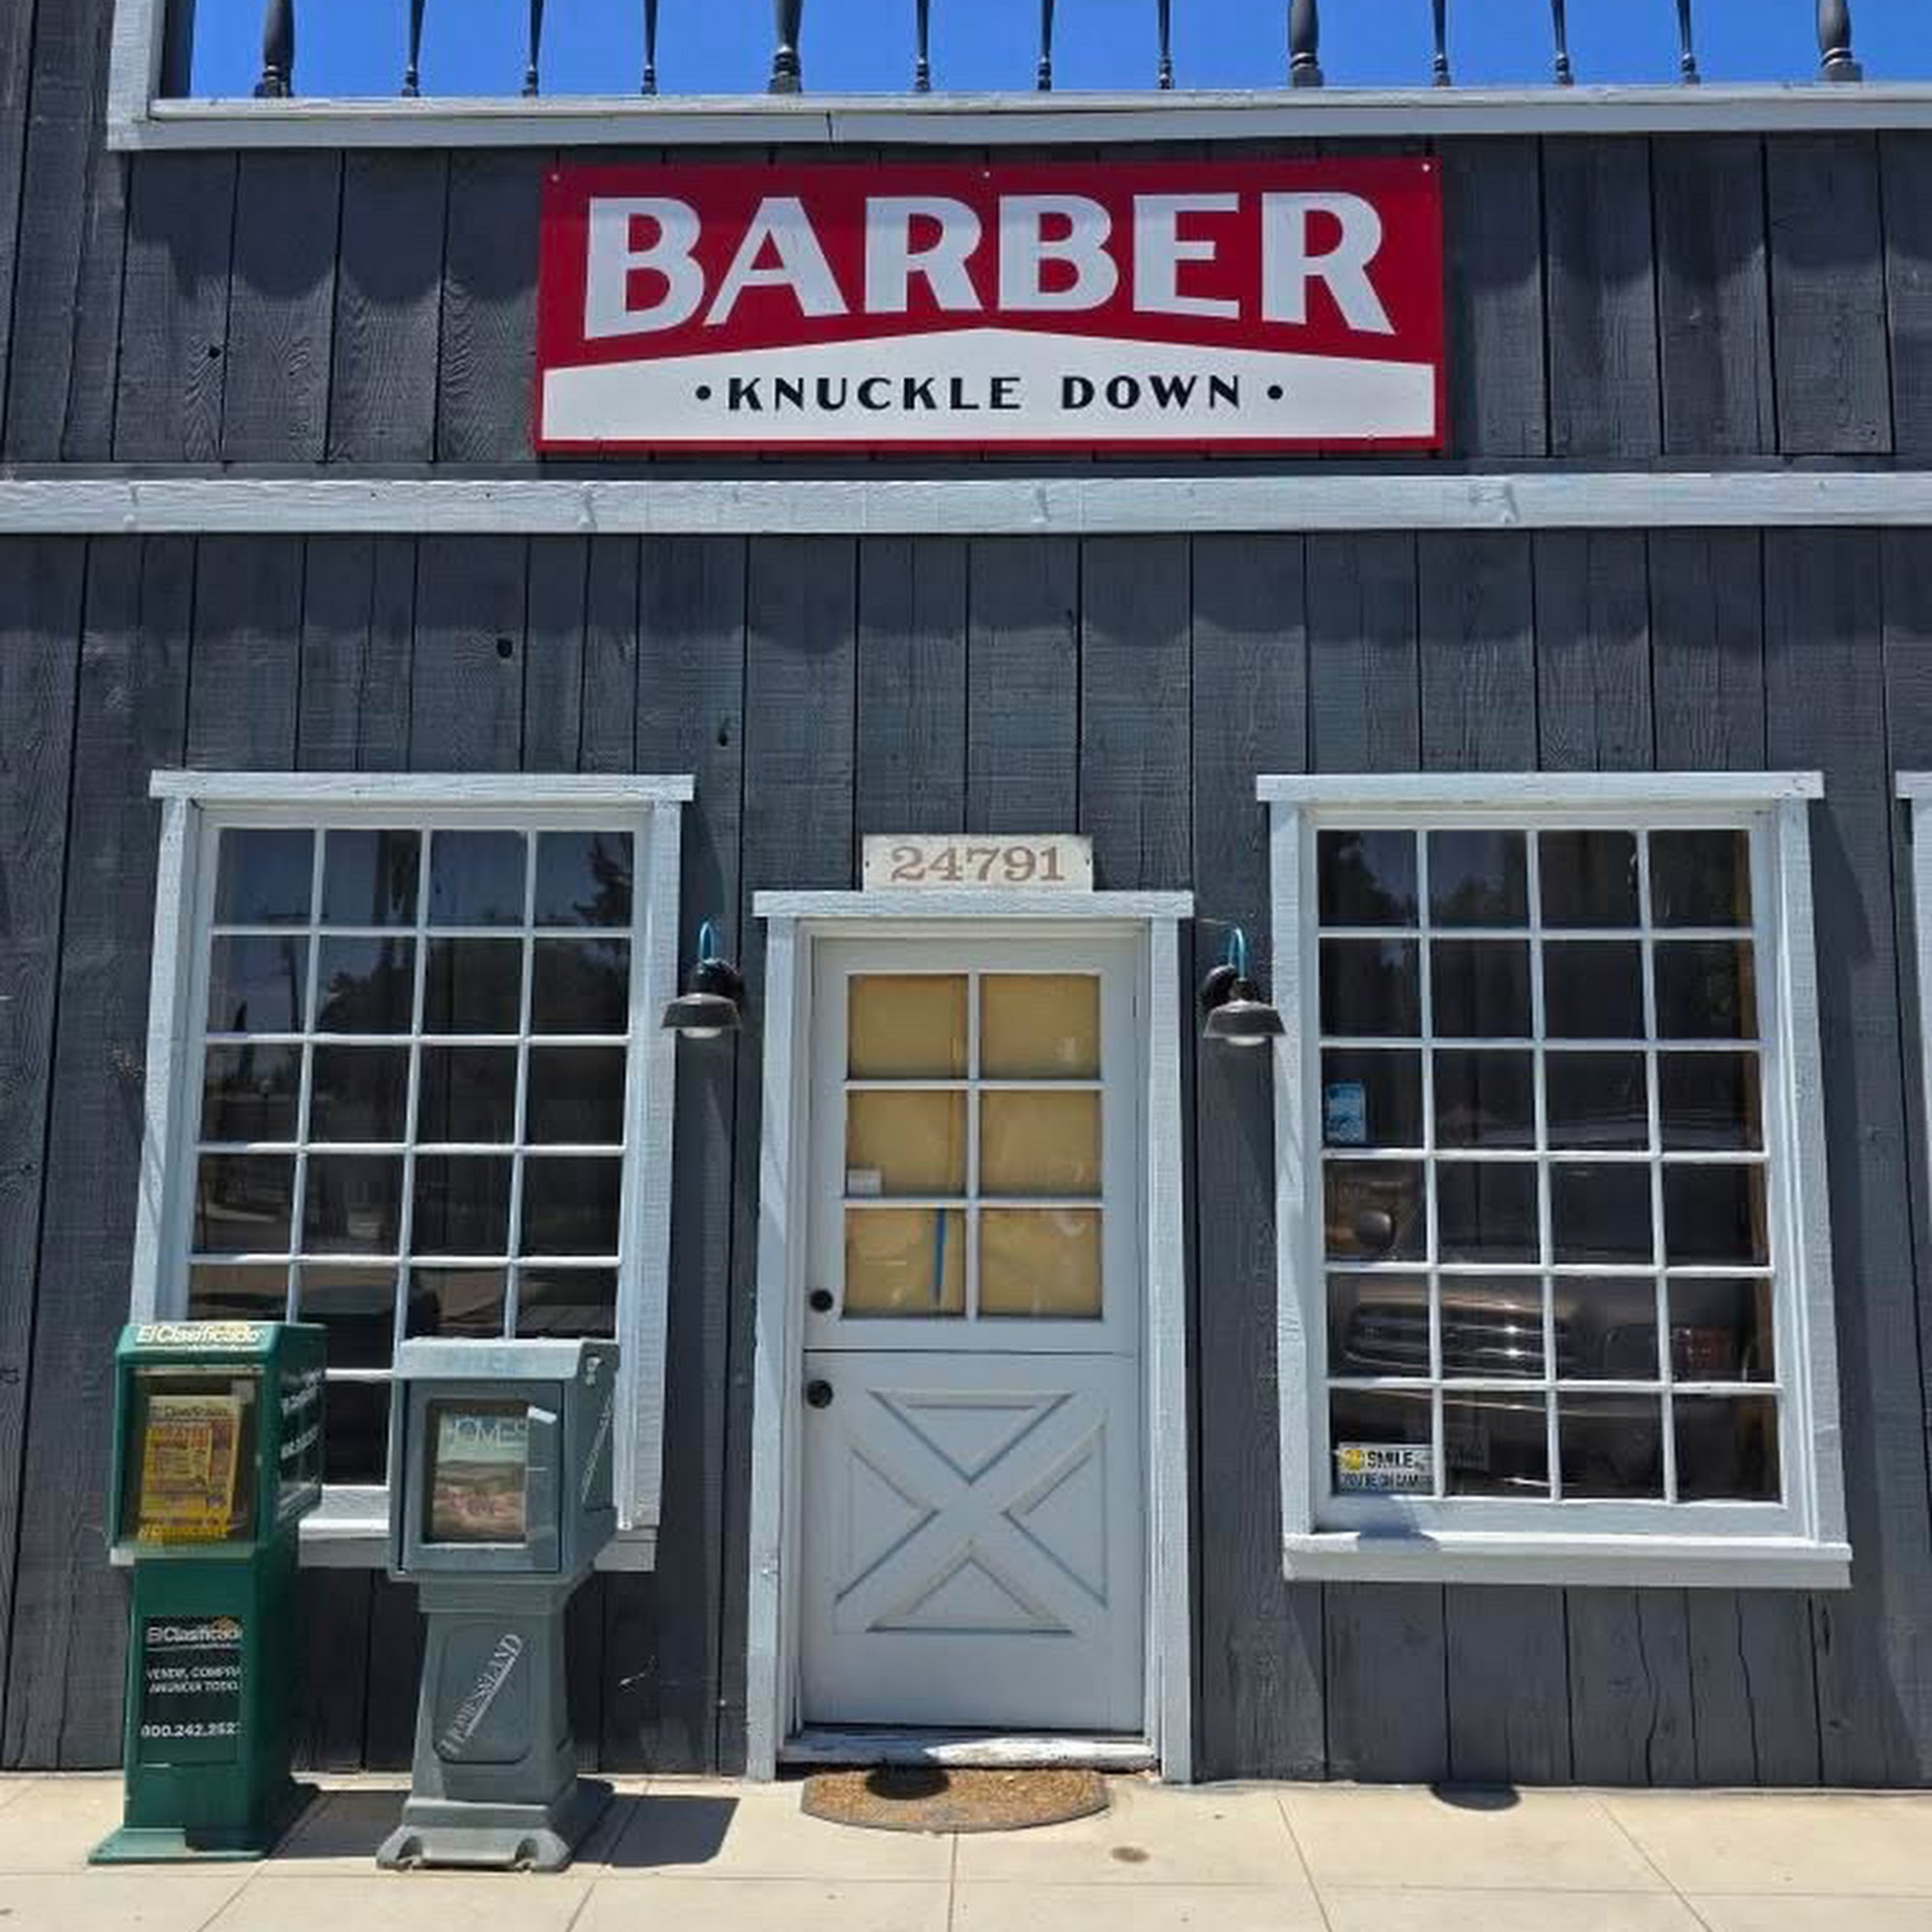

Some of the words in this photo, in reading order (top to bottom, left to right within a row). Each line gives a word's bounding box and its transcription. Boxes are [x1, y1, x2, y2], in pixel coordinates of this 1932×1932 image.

[584, 191, 1396, 340] BARBER
[728, 377, 1022, 412] KNUCKLE
[1063, 375, 1241, 410] DOWN
[891, 845, 1065, 882] 24791
[1367, 1450, 1414, 1468] SMILE
